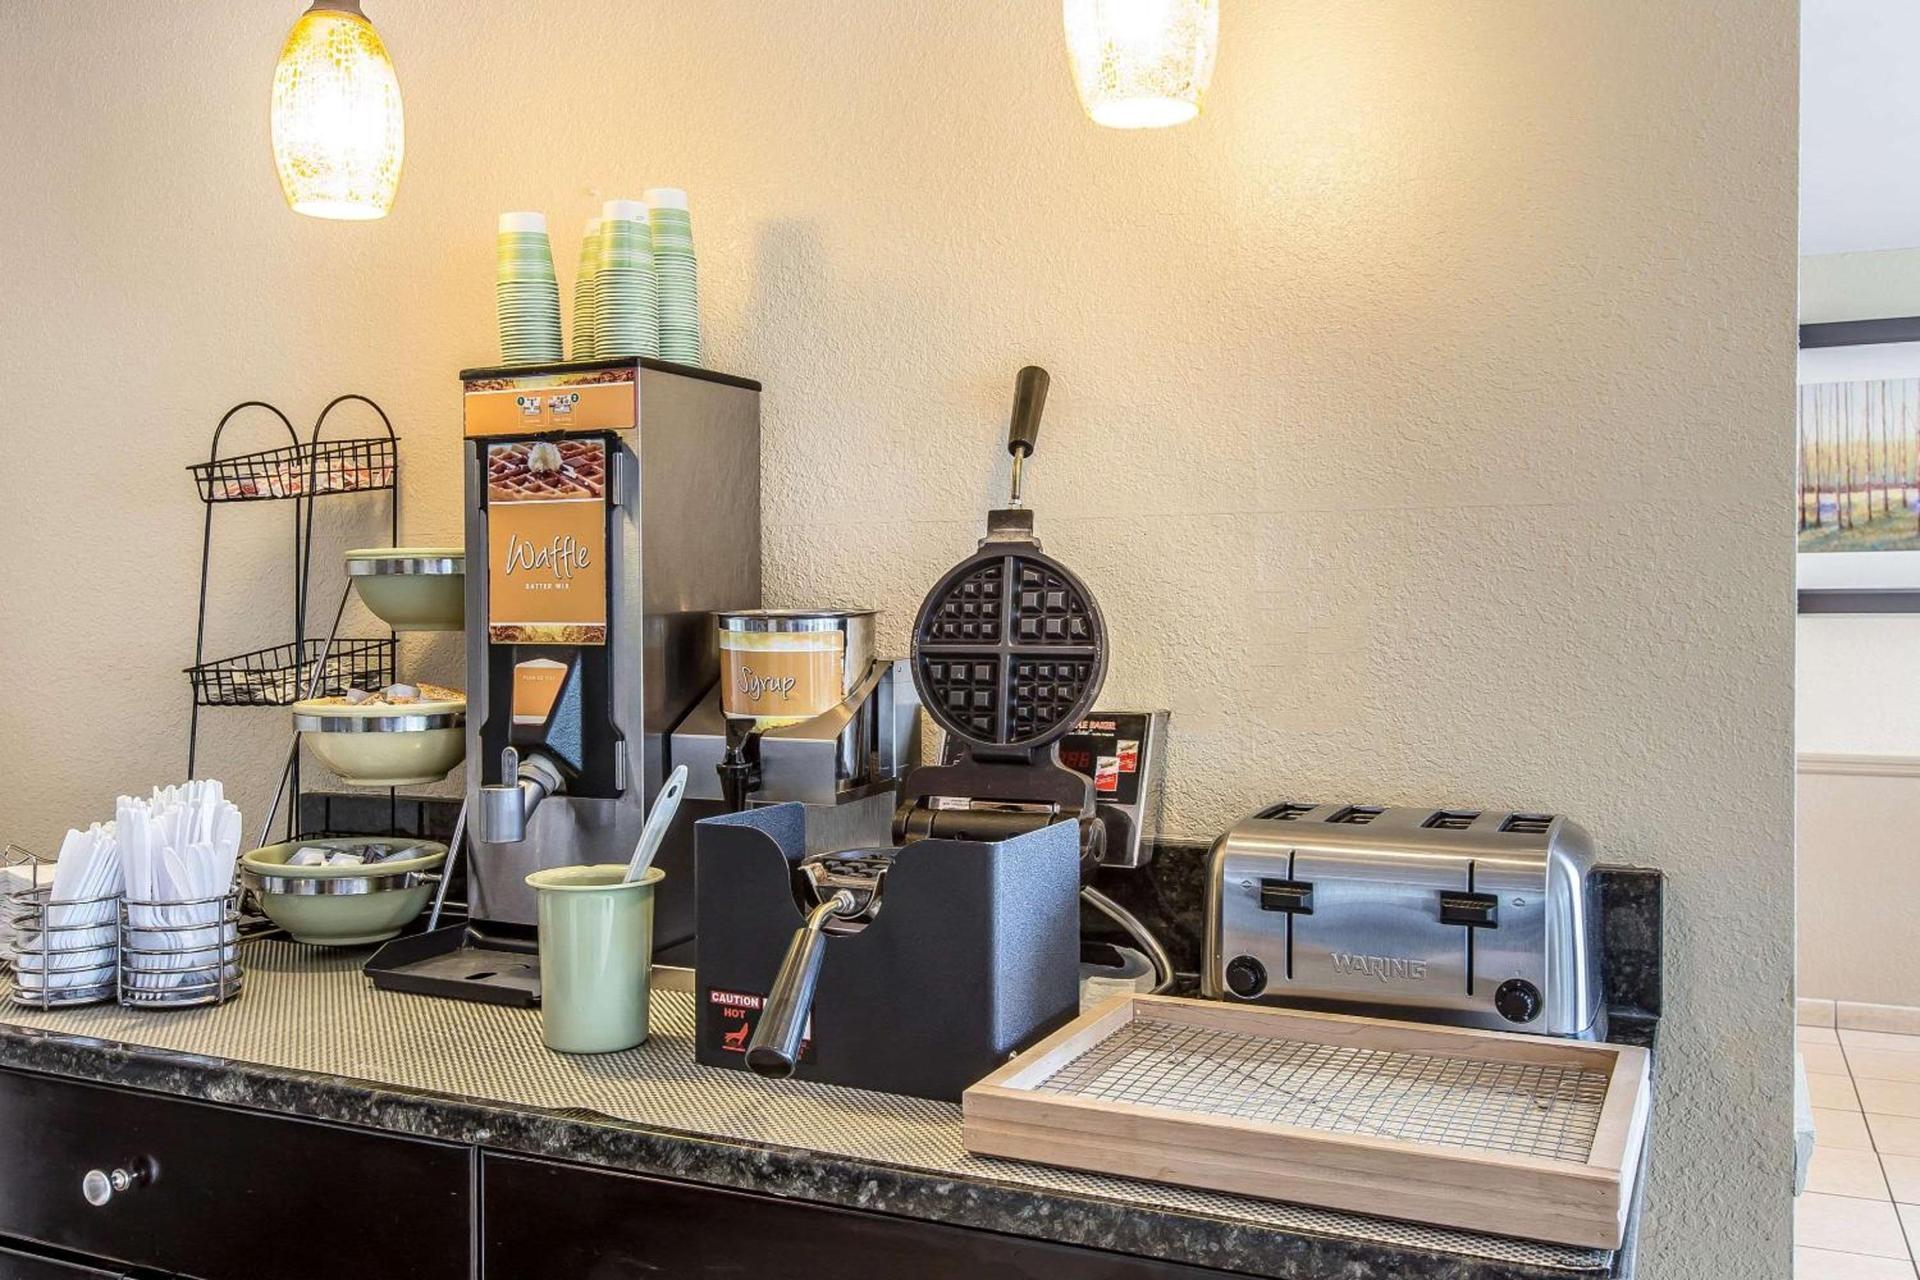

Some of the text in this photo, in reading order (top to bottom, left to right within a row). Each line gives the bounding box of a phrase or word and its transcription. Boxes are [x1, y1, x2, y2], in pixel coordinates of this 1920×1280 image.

[506, 534, 591, 578] Waffle
[737, 665, 796, 700] Syrup
[1330, 952, 1429, 983] WARING
[711, 991, 760, 1008] CAUTION
[723, 1007, 746, 1019] HOT
